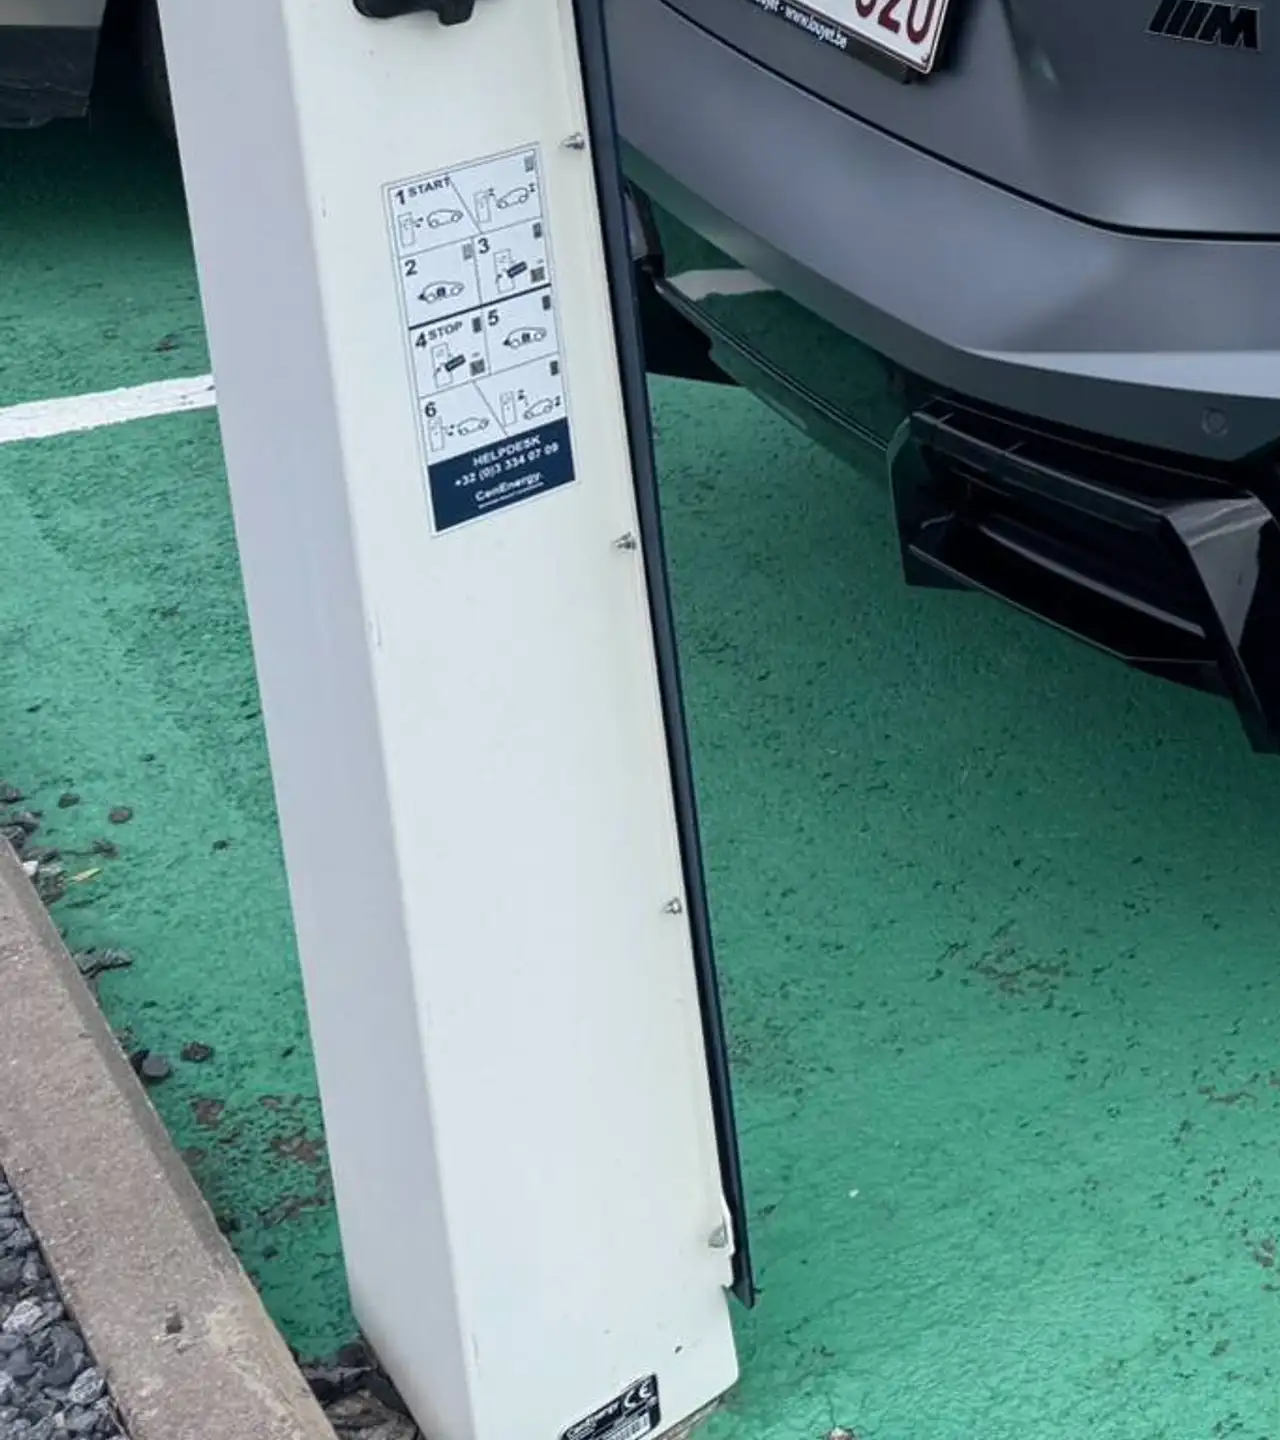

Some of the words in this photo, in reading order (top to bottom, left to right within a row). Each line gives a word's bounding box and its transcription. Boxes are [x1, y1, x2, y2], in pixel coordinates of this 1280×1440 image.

[396, 190, 406, 206] 1
[408, 176, 450, 198] START
[477, 237, 490, 254] 3
[404, 259, 418, 277] 2
[487, 309, 499, 327] 5
[415, 331, 428, 348] 4
[428, 321, 463, 341] STOP
[424, 401, 437, 418] 6
[473, 435, 541, 467] HELPDESK
